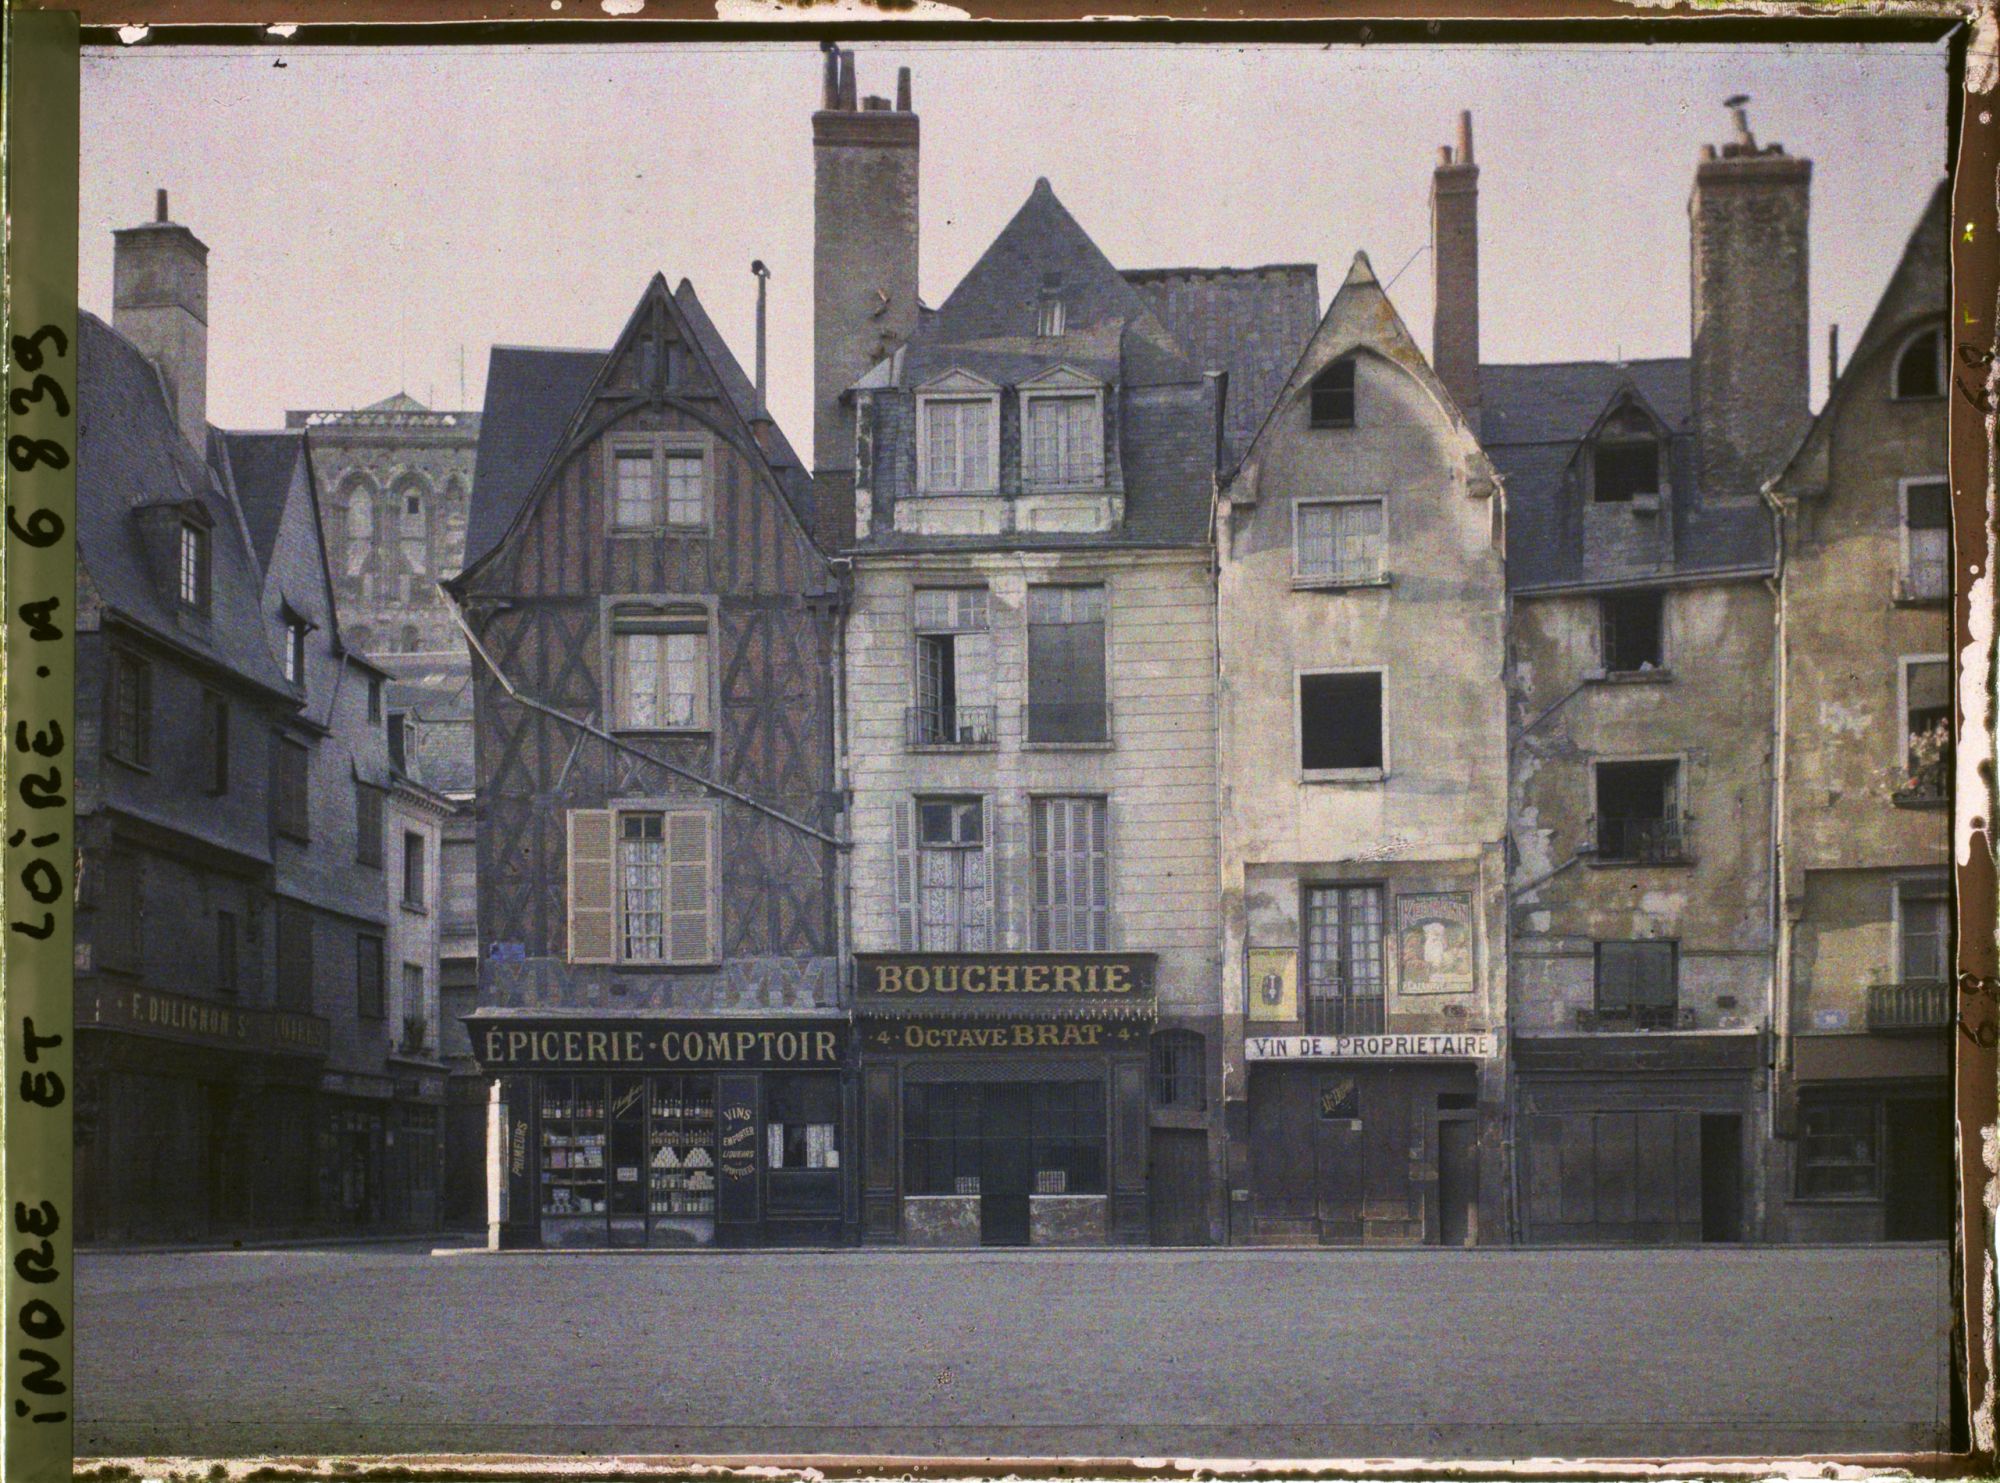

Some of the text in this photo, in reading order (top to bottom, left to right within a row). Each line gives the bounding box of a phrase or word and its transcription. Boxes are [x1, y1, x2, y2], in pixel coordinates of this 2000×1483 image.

[876, 965, 1131, 993] BOUCHERIE
[485, 1026, 837, 1062] ÉPICERIE COMPTOIR
[877, 1024, 1131, 1048] 4 OCTAVE BRAT 4
[1253, 1036, 1489, 1057] VIN DE PROPRIETAIRE
[20, 1016, 65, 1108] ET
[723, 1107, 752, 1121] VINS
[511, 1120, 529, 1177] PRIMEURS
